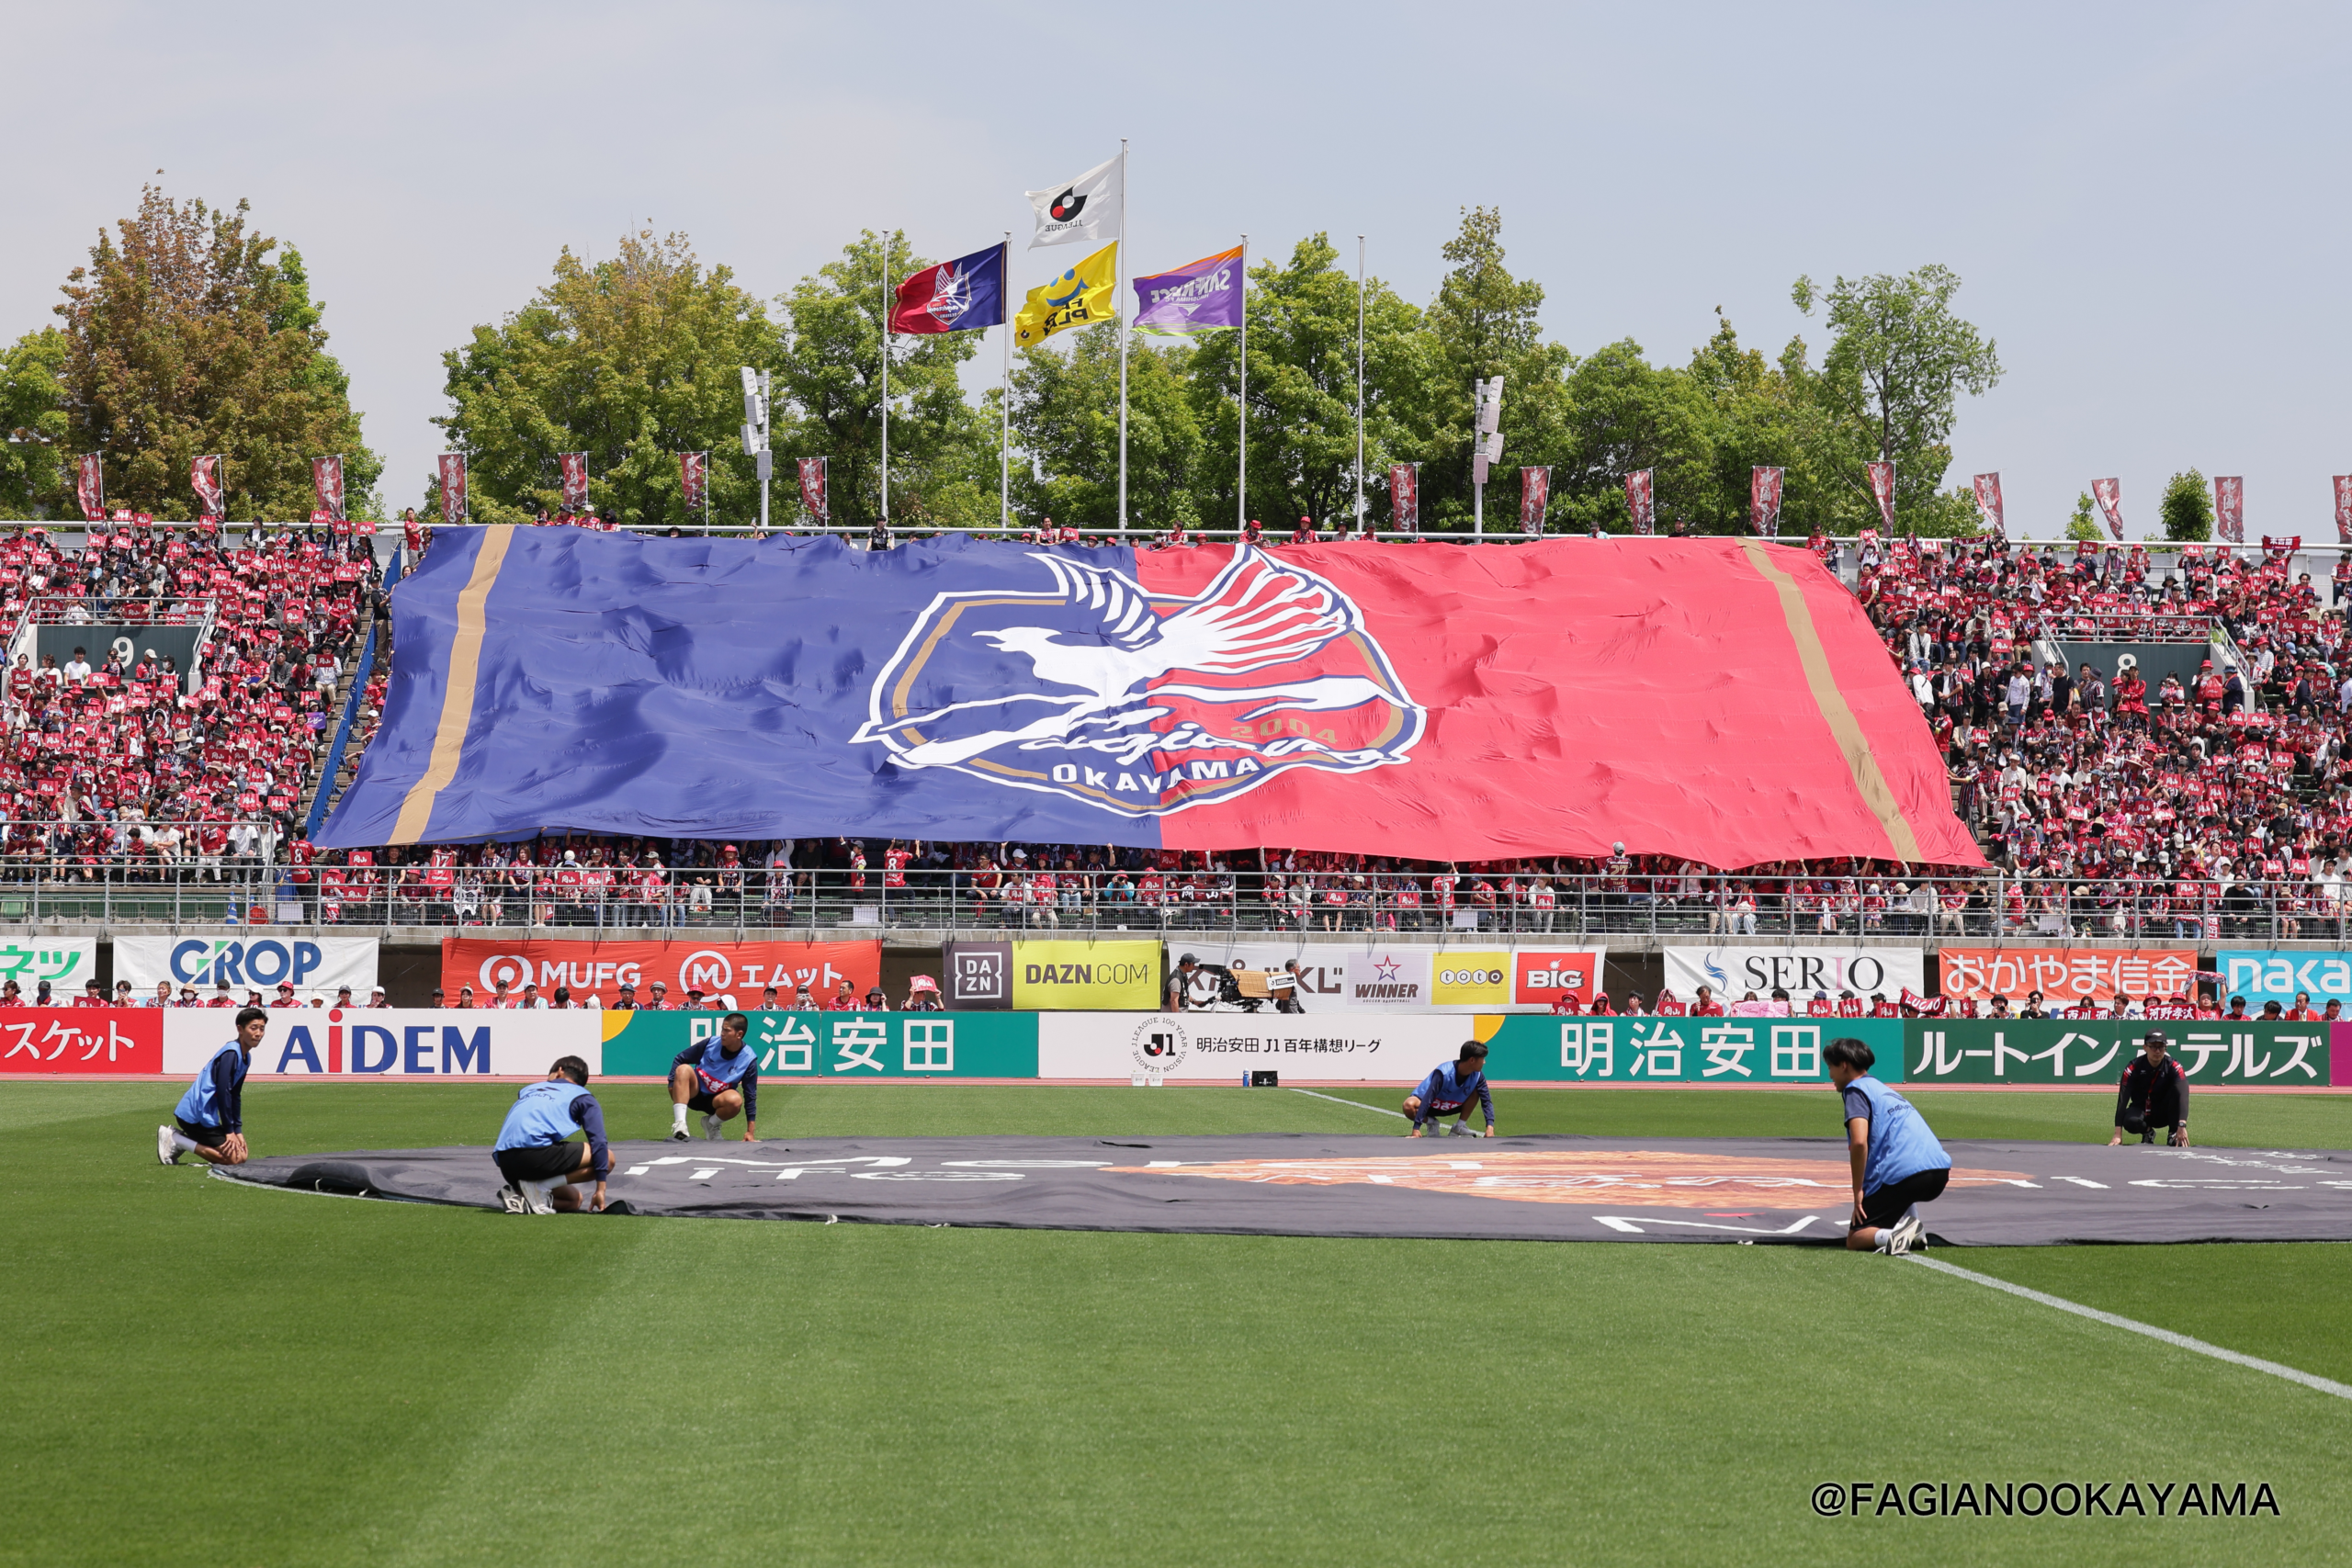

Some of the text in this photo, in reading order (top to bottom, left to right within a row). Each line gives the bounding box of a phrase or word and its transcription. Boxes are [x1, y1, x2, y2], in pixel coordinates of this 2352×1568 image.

[112, 637, 134, 668] 9
[2117, 653, 2137, 677] 8
[1229, 717, 1338, 745] 2004
[1052, 756, 1261, 794] OKAYAMA
[170, 939, 322, 986] GROP
[540, 961, 642, 987] MUFG
[740, 963, 843, 988] エムット
[1025, 964, 1148, 984] DAZN.COM
[1744, 956, 1884, 991] SERIO
[1946, 953, 2191, 995] おかやま信金
[2228, 958, 2352, 994] naka
[1355, 984, 1419, 998] WINNER
[1440, 969, 1504, 985] toto
[1526, 969, 1586, 988] BIG
[1161, 1017, 1176, 1027] 100
[0, 1020, 135, 1062] スケット
[277, 1010, 491, 1073] AiDEM
[1196, 1037, 1382, 1054] 明治安田 J1 百年構想リーグ
[1561, 1021, 1820, 1077] 明治安田
